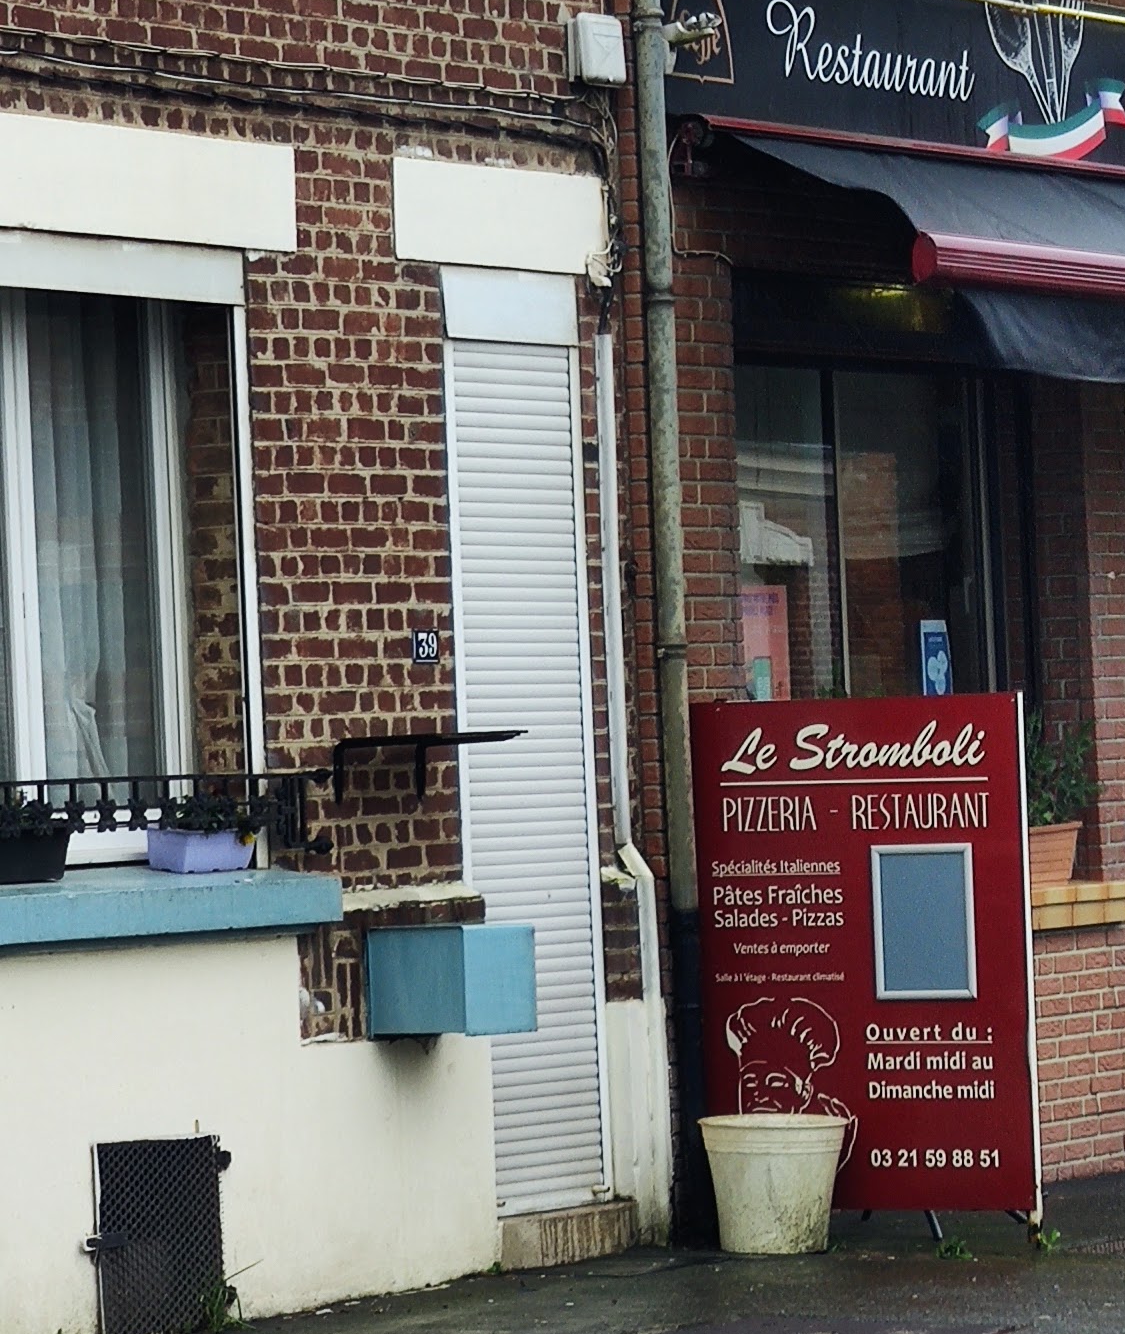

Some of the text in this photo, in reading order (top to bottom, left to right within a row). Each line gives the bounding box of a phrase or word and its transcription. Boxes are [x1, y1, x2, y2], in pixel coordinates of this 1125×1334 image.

[417, 632, 438, 658] 39
[720, 719, 985, 775] Le Stromboli
[723, 796, 818, 832] PIZZERIA
[851, 792, 990, 830] RESTAURANT
[711, 858, 841, 877] Spécialités Italiennes
[713, 883, 843, 905] Pâtes Fraîches
[714, 908, 778, 928] Salades
[792, 907, 845, 927] Pizzas
[733, 941, 830, 957] Ventes à emporter
[772, 972, 811, 983] Restaurant
[866, 1023, 942, 1041] Ouvert
[952, 1021, 977, 1041] du
[867, 1050, 994, 1070] Mardi midi au
[868, 1079, 995, 1099] Dimanche midi
[870, 1148, 1000, 1168] 03 21 59 88 51
